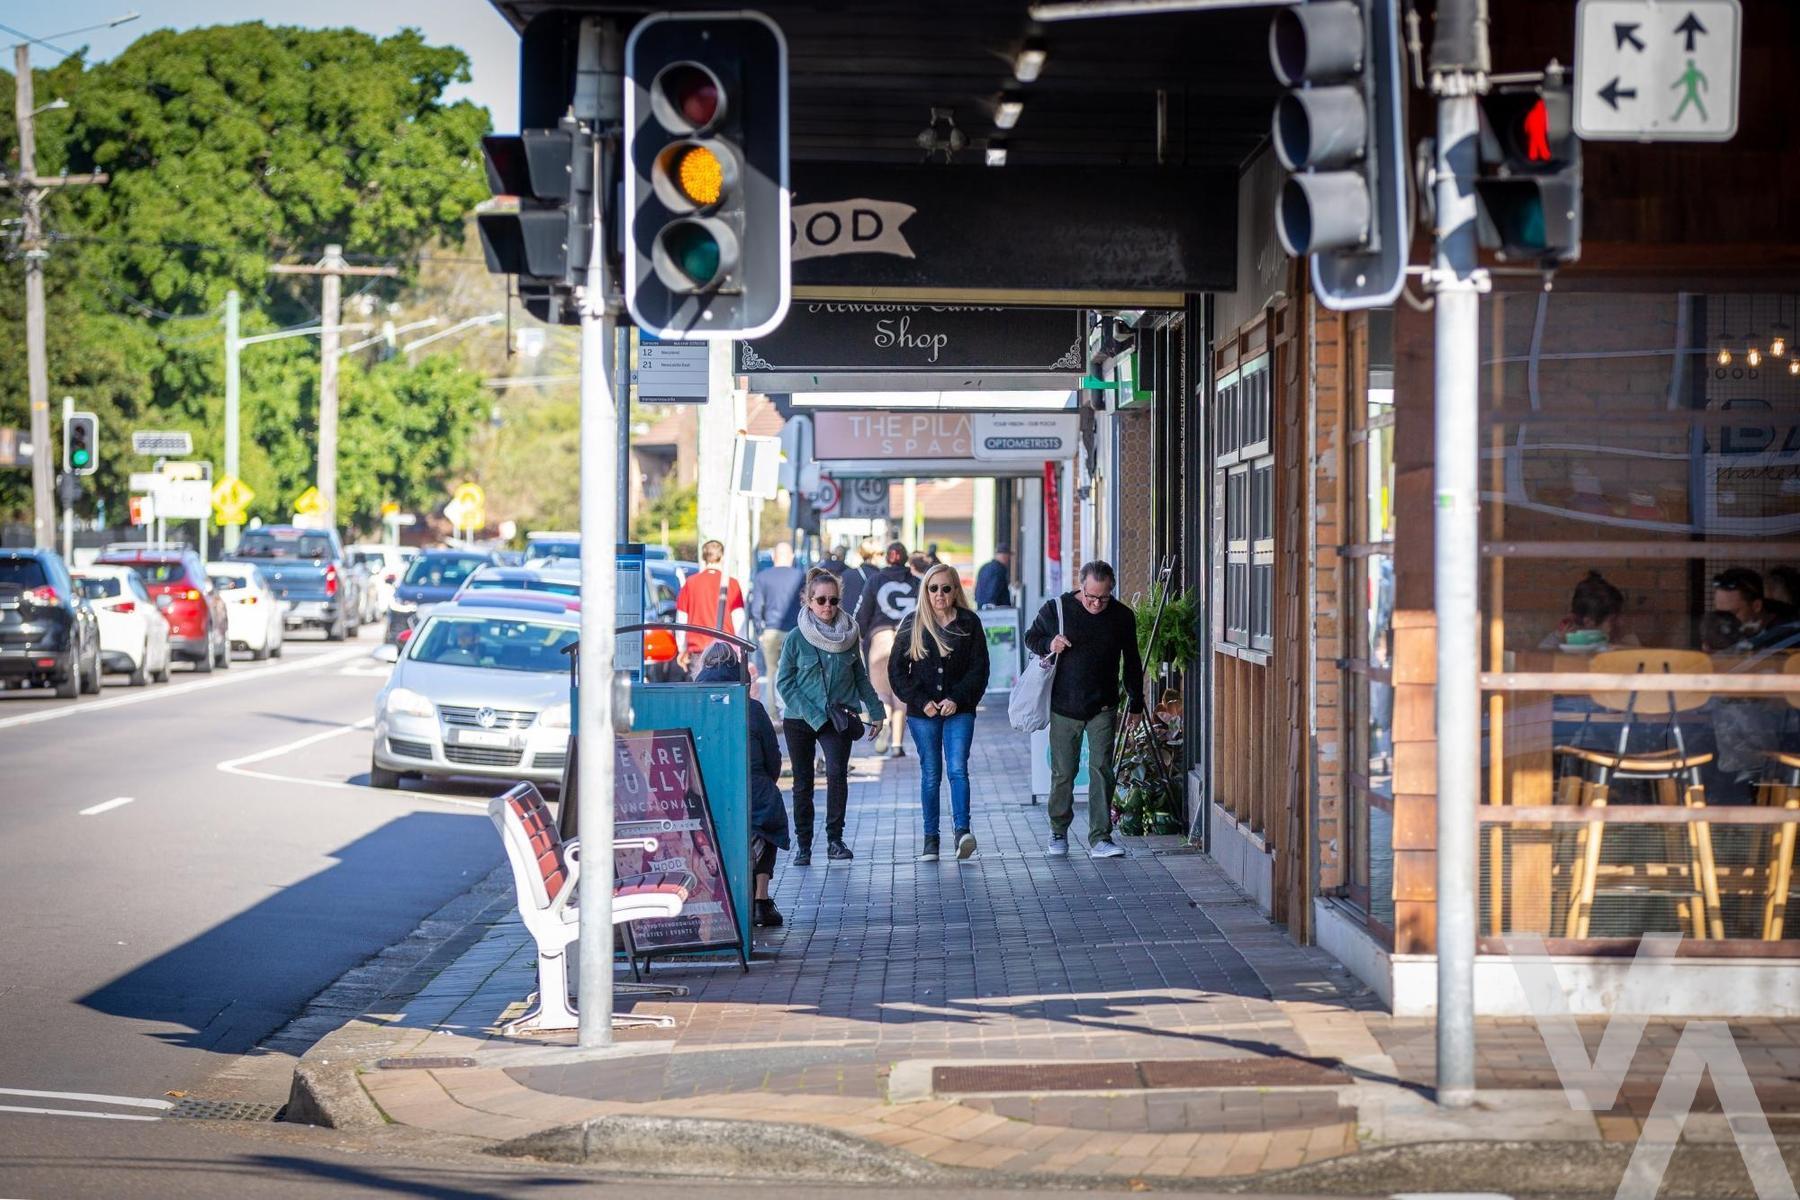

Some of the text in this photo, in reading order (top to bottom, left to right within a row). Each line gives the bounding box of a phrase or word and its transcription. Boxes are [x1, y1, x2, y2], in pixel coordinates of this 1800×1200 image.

[791, 208, 884, 246] OD
[874, 315, 948, 363] Shop
[642, 348, 653, 357] 12
[642, 360, 653, 369] 21
[1708, 367, 1759, 380] OOD
[848, 414, 971, 438] THE PILA
[881, 439, 966, 454] SPAC
[986, 438, 1060, 449] OPTOMETRISTS
[877, 581, 917, 620] G
[643, 747, 684, 766] ARE
[616, 769, 686, 794] ULLY
[615, 798, 696, 814] UNCTIONAL
